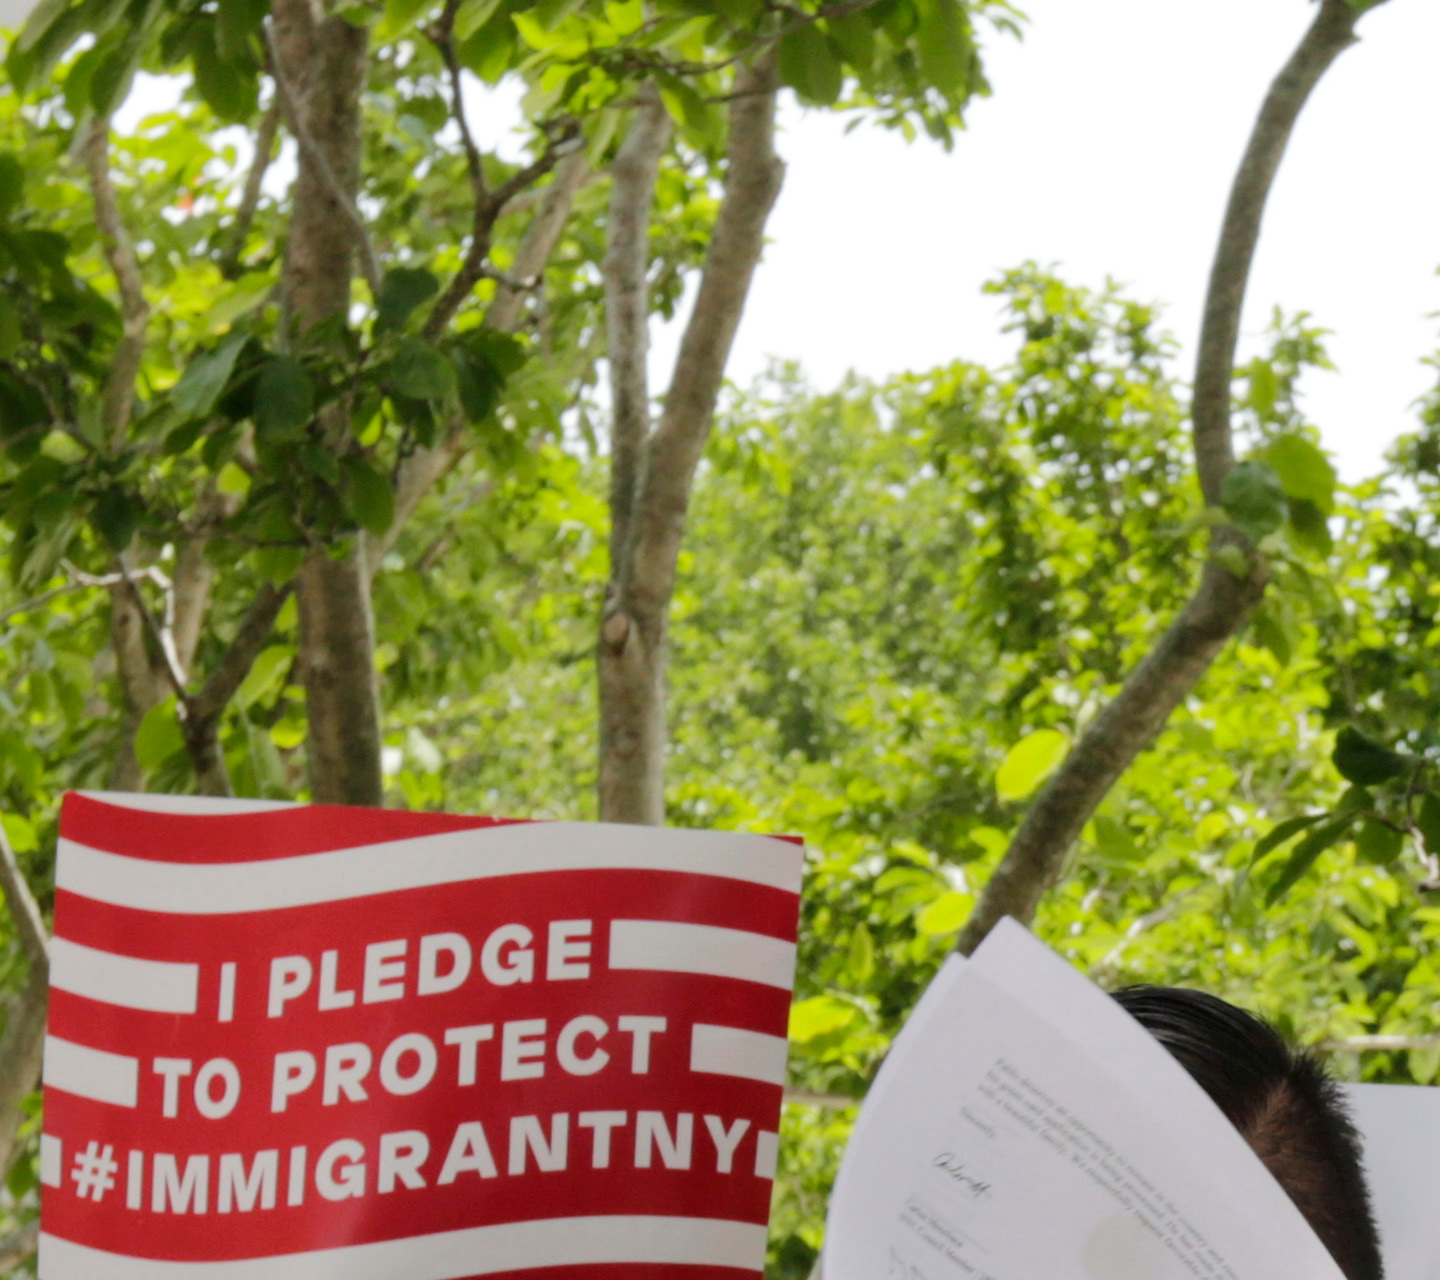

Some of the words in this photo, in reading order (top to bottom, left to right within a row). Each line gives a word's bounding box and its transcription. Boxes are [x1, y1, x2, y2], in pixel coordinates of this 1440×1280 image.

[217, 960, 237, 1023] I
[266, 918, 594, 1020] PLEDGE
[152, 1055, 242, 1121] TO
[269, 1014, 669, 1114] PROTECT
[70, 1109, 752, 1217] #IMMIGRANTNY
